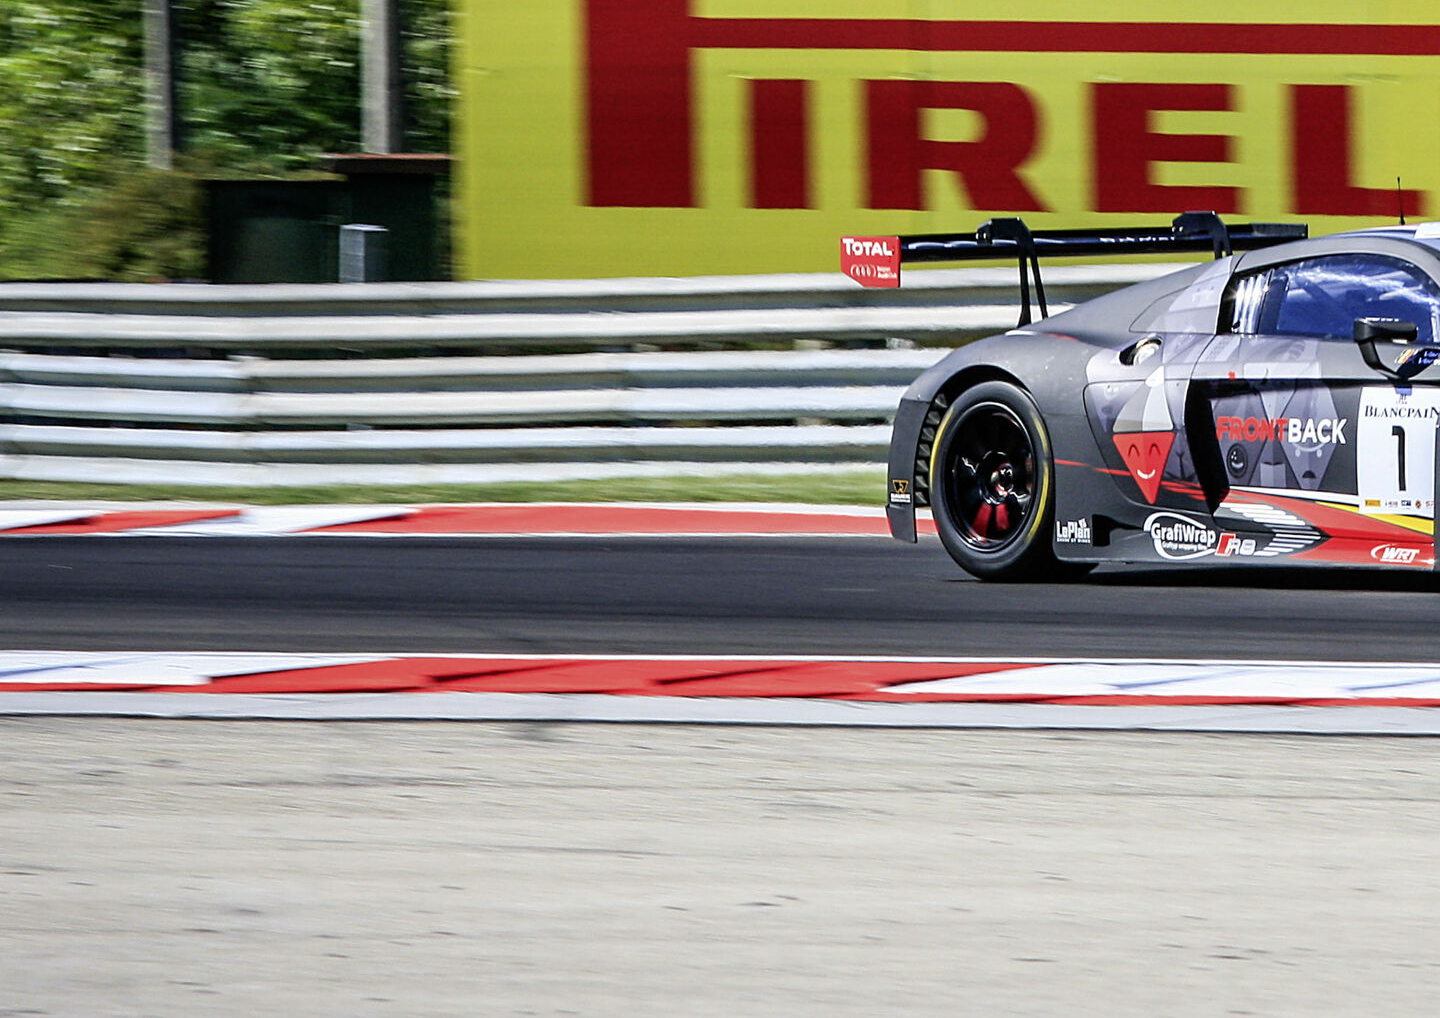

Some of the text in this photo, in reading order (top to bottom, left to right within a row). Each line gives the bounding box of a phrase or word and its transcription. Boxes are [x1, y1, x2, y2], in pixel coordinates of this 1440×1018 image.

[842, 238, 893, 256] TOTAL
[1365, 405, 1440, 419] BLANCPAIN
[1216, 416, 1347, 444] FRONTBACK
[1391, 425, 1406, 491] 1
[1151, 522, 1216, 547] GrafiWrap
[1380, 547, 1420, 563] WRT
